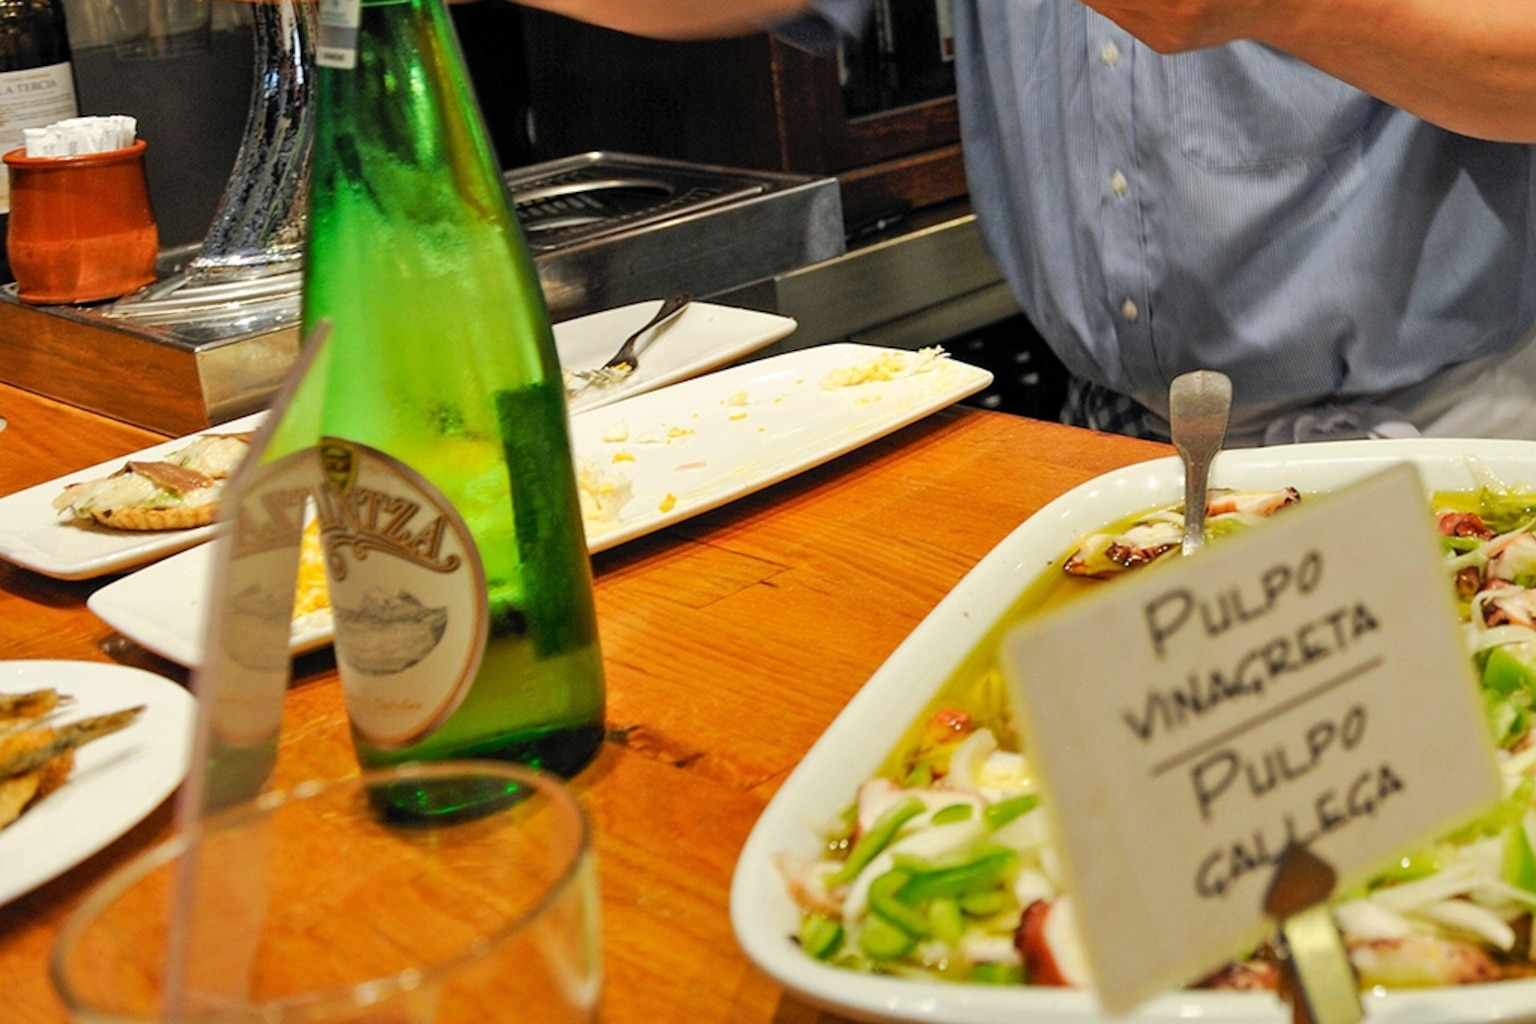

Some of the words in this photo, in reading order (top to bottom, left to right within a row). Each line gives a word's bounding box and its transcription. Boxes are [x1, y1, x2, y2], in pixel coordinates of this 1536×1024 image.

[1143, 549, 1324, 662] PULPO
[1121, 600, 1382, 742] VINAGRETA
[1191, 703, 1368, 821] PULPO
[1194, 761, 1407, 900] GALLEGA
